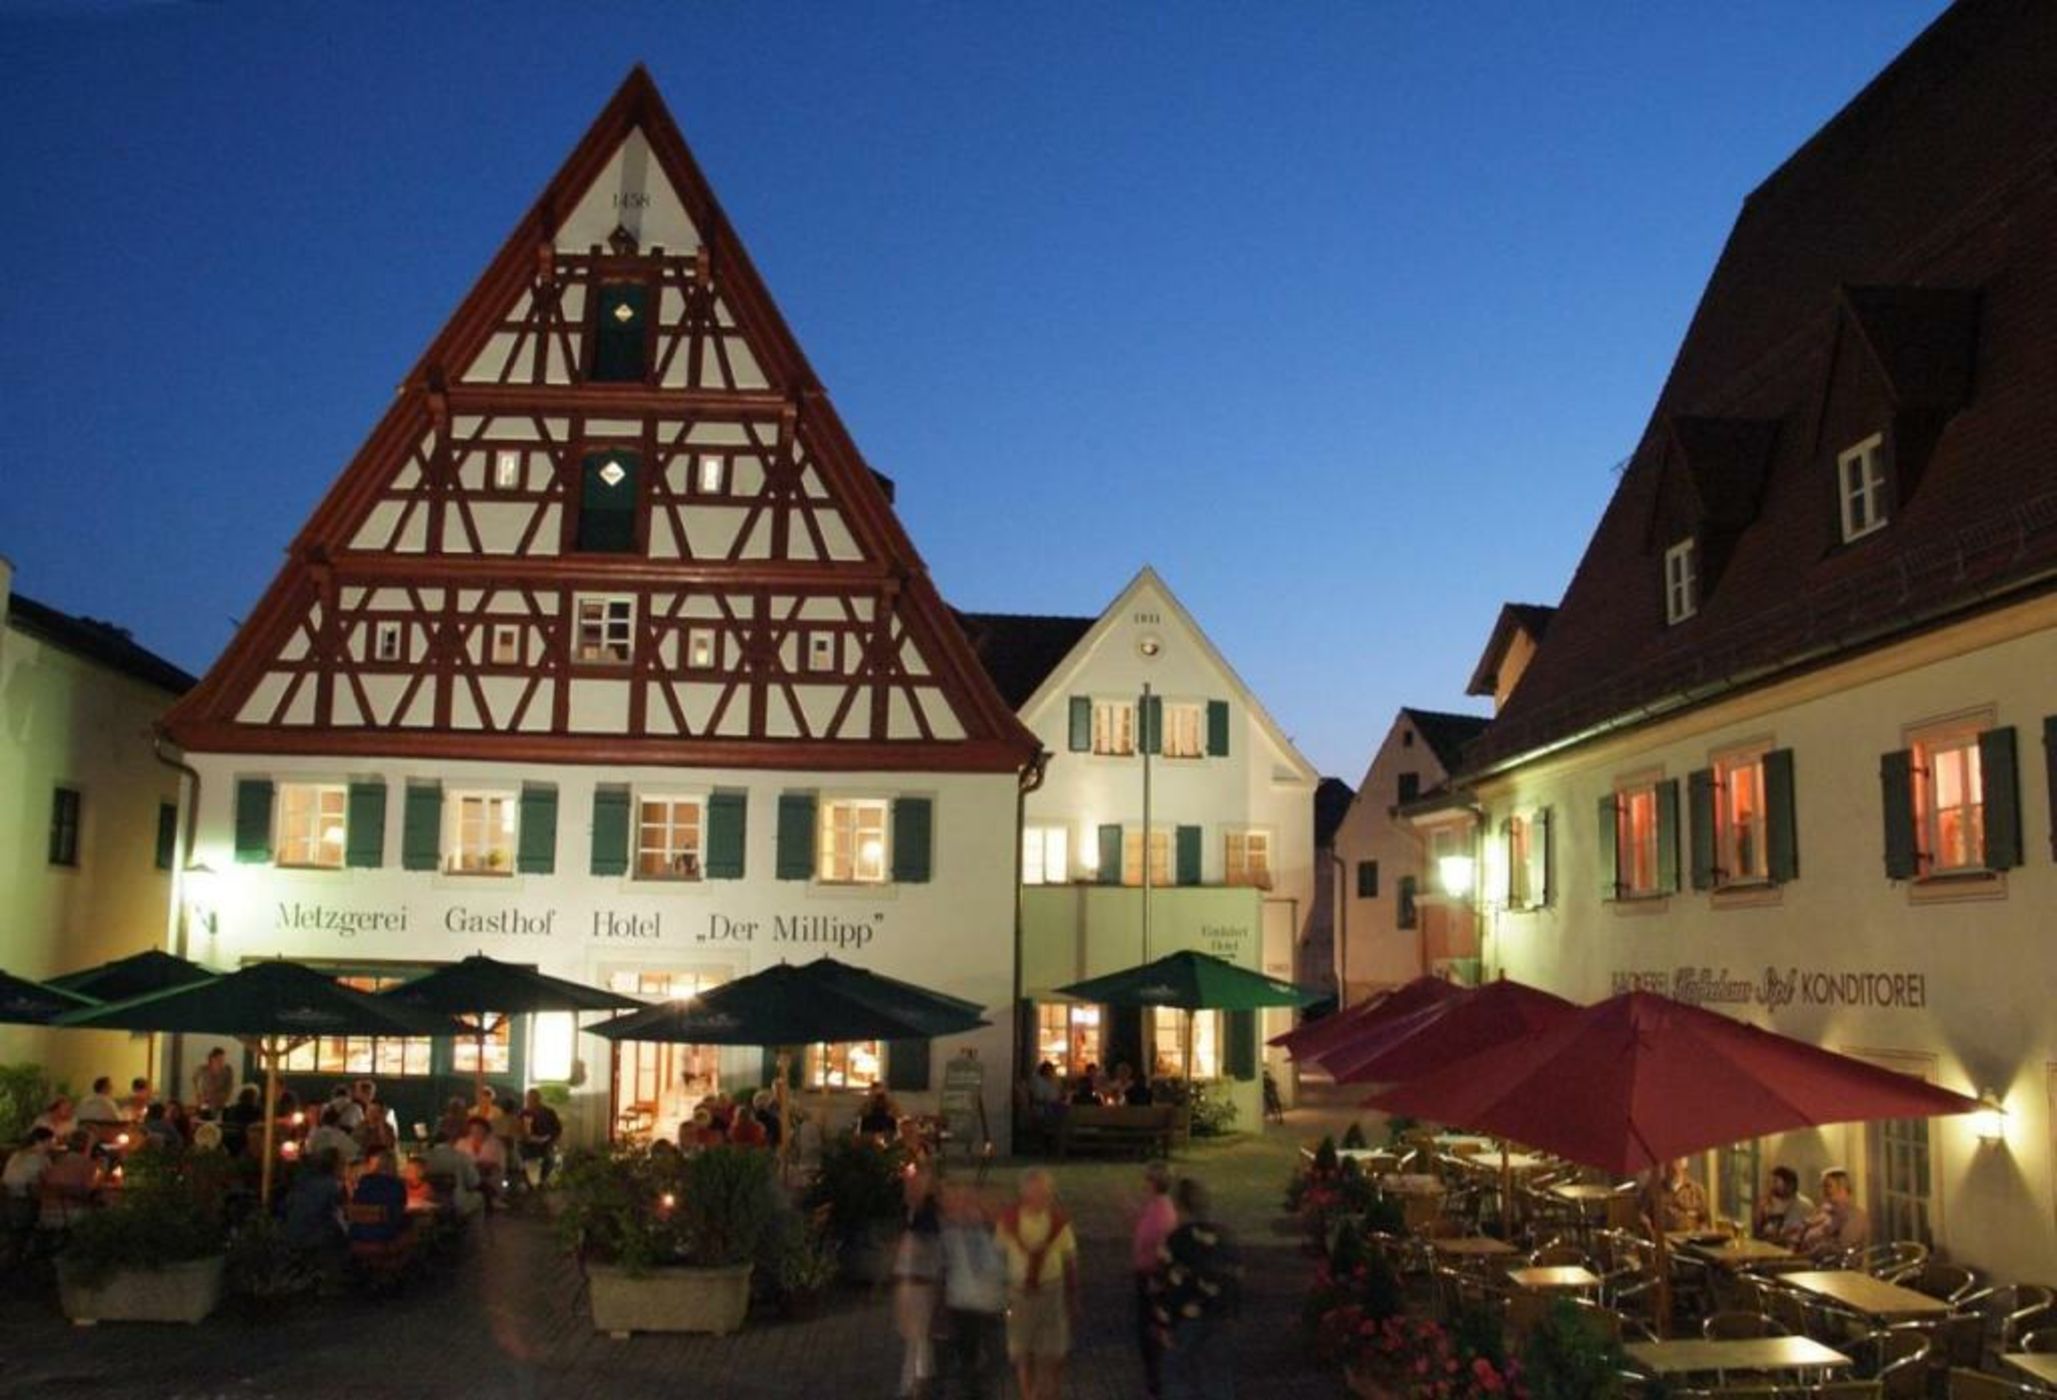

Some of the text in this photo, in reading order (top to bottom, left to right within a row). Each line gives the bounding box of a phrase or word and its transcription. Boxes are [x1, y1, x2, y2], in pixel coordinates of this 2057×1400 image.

[277, 902, 409, 937] Metzgerei
[445, 905, 556, 935] Gasthof
[593, 911, 661, 938] Hotel
[1801, 972, 1926, 1008] KONDITOREI
